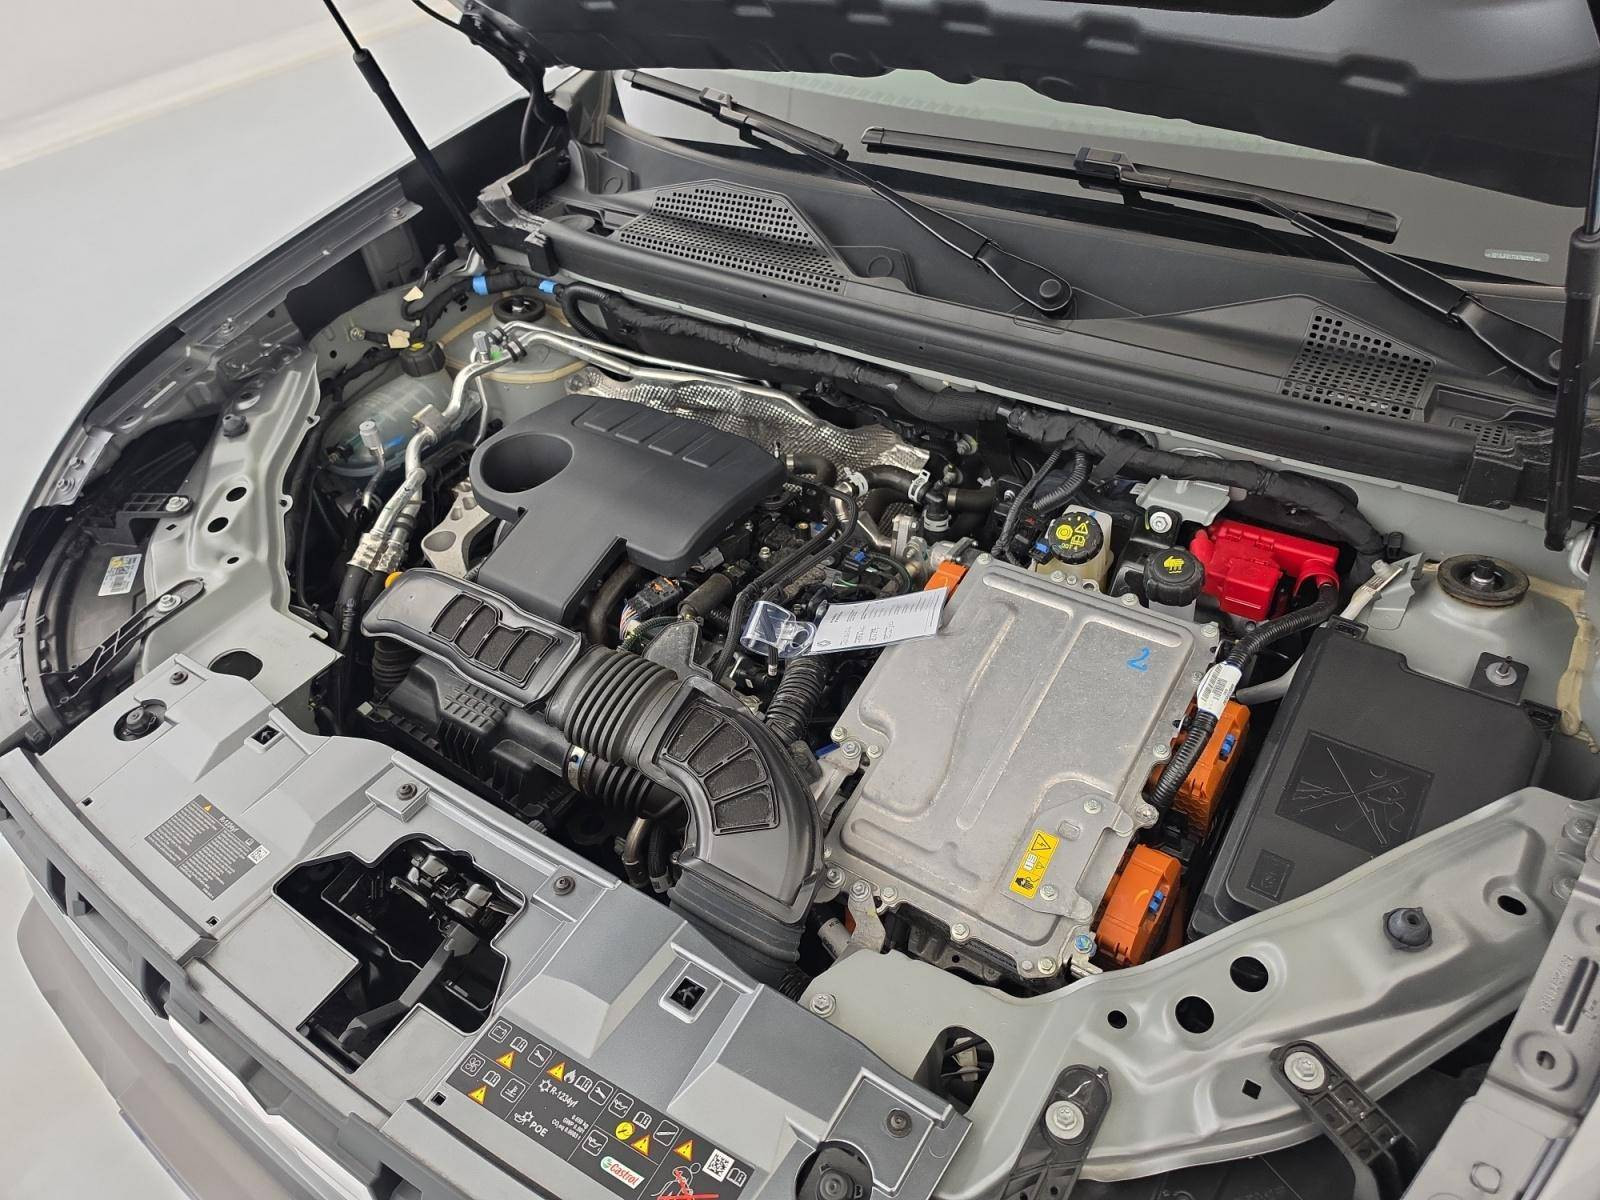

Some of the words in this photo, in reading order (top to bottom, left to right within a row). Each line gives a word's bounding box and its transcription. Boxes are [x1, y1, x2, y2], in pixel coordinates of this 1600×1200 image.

[1126, 646, 1151, 673] 2
[549, 1086, 579, 1108] R-1234yf
[529, 1120, 549, 1138] POE
[610, 1163, 640, 1185] Castrol
